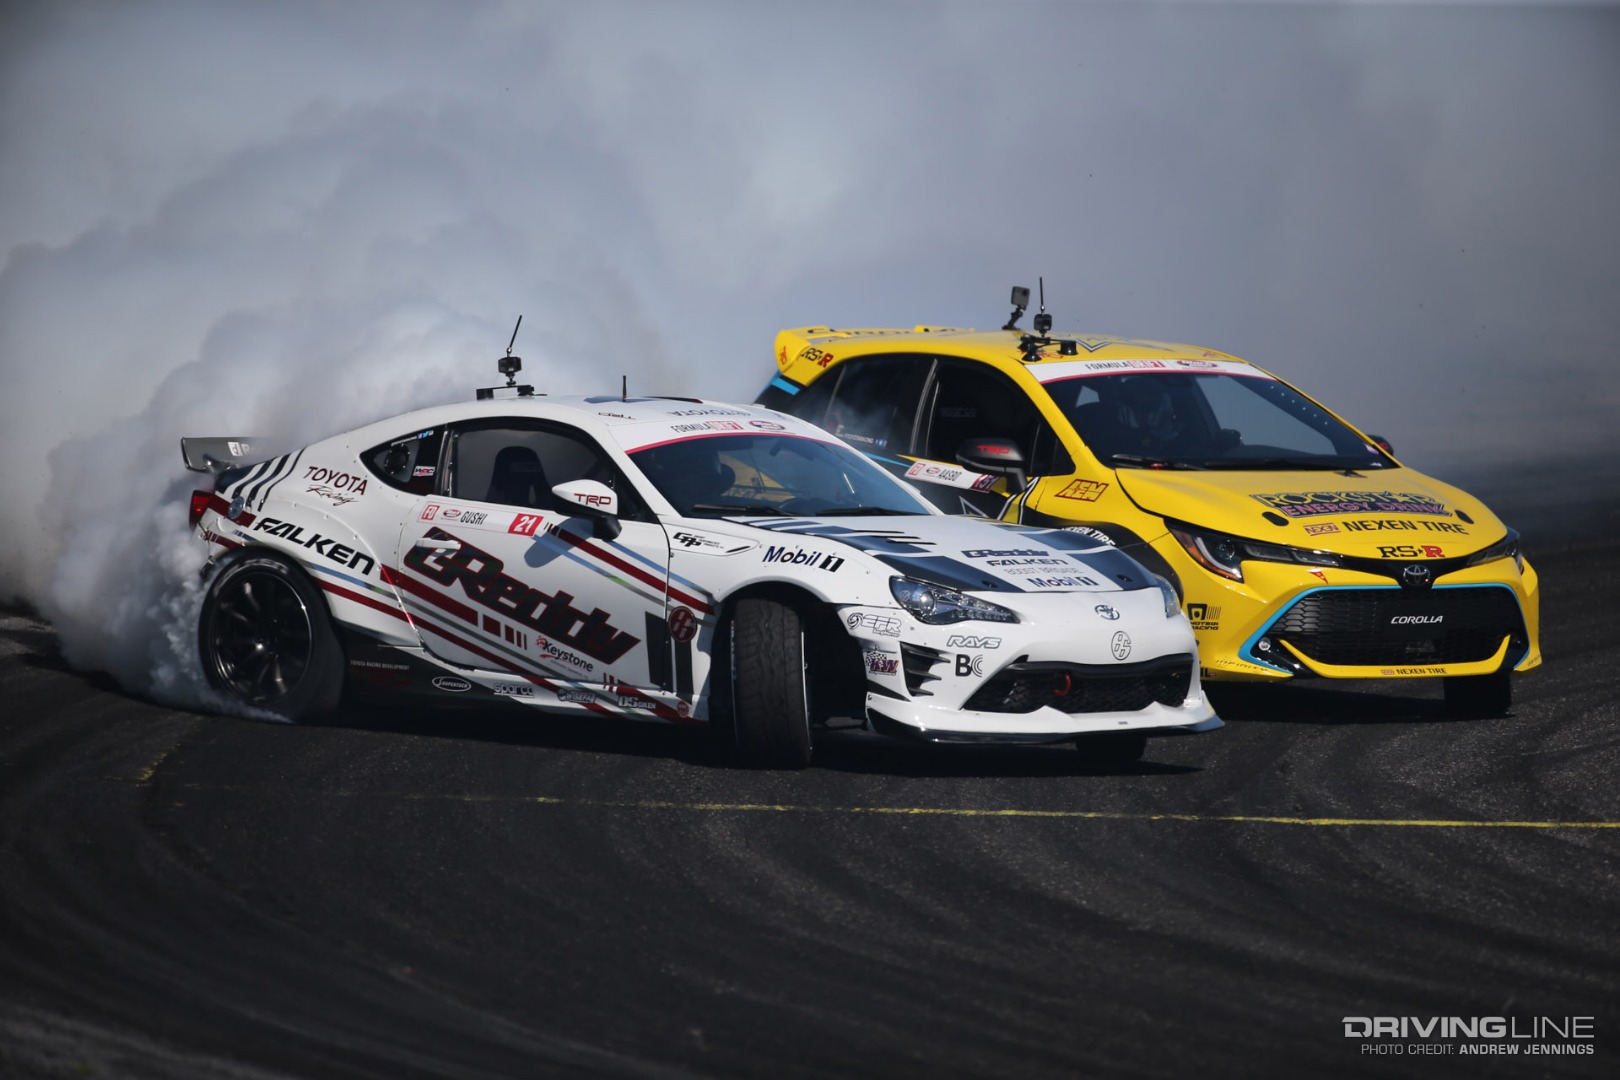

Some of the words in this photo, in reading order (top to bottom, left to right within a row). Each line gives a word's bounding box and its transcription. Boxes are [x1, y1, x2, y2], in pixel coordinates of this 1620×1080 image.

[303, 466, 368, 495] TOYOTA
[574, 493, 612, 507] TRD
[1282, 503, 1371, 516] ENERGY
[1379, 502, 1452, 516] DRINK
[460, 511, 488, 525] GUSHI
[513, 516, 537, 533] 21
[1343, 520, 1418, 532] NEXEN
[1420, 521, 1469, 535] TIRE
[253, 517, 375, 576] FALKEN
[762, 546, 822, 566] Mobil
[819, 555, 845, 572] 1
[1027, 576, 1080, 587] Mobil
[403, 526, 641, 665] GReddy
[1391, 615, 1443, 624] COROLLA
[947, 635, 1002, 649] RAYS
[543, 638, 593, 672] Keystone
[494, 683, 535, 697] sparco
